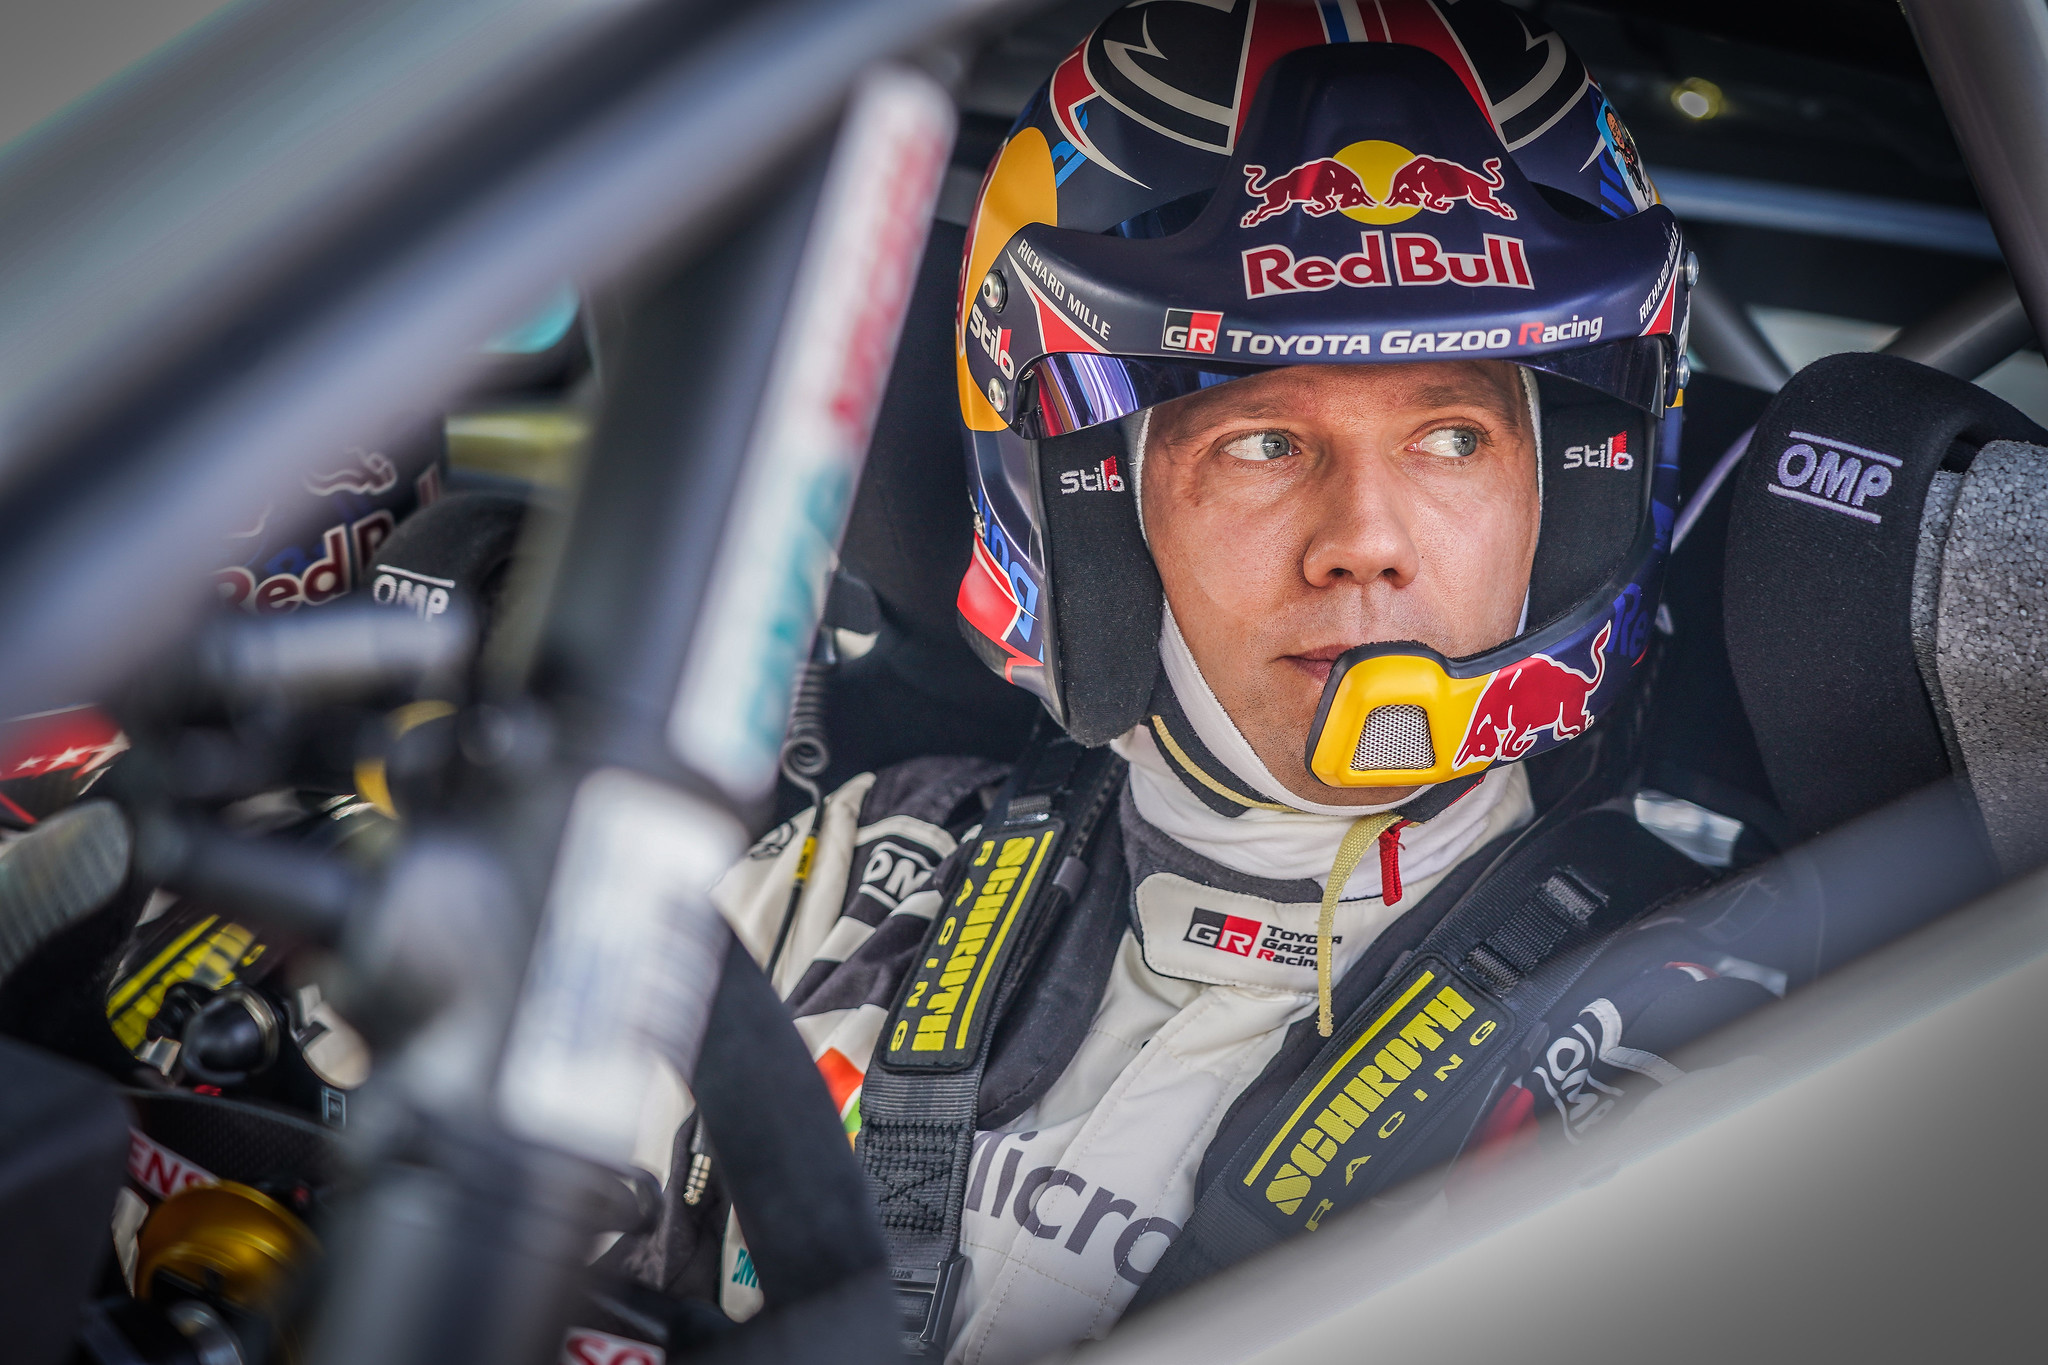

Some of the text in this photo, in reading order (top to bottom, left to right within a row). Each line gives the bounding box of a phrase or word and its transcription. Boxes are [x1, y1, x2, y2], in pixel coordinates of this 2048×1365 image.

[1017, 238, 1112, 341] RICHARD MILLE
[1241, 230, 1535, 300] Red Bull
[1639, 260, 1670, 324] RICHARD
[969, 303, 1015, 381] Stilo
[1226, 329, 1371, 355] TOYOTA
[1380, 328, 1512, 354] GAZOO
[1517, 315, 1603, 346] Racing
[1059, 460, 1125, 494] Stilo
[1563, 431, 1634, 471] Stilo
[1777, 443, 1893, 507] OMP
[373, 573, 450, 623] OMP
[889, 839, 996, 1052] RACING
[910, 836, 1036, 1052] SCHROTH
[1188, 922, 1252, 955] GR
[1265, 985, 1476, 1216] SCHROTH
[1304, 1019, 1497, 1232] RACING
